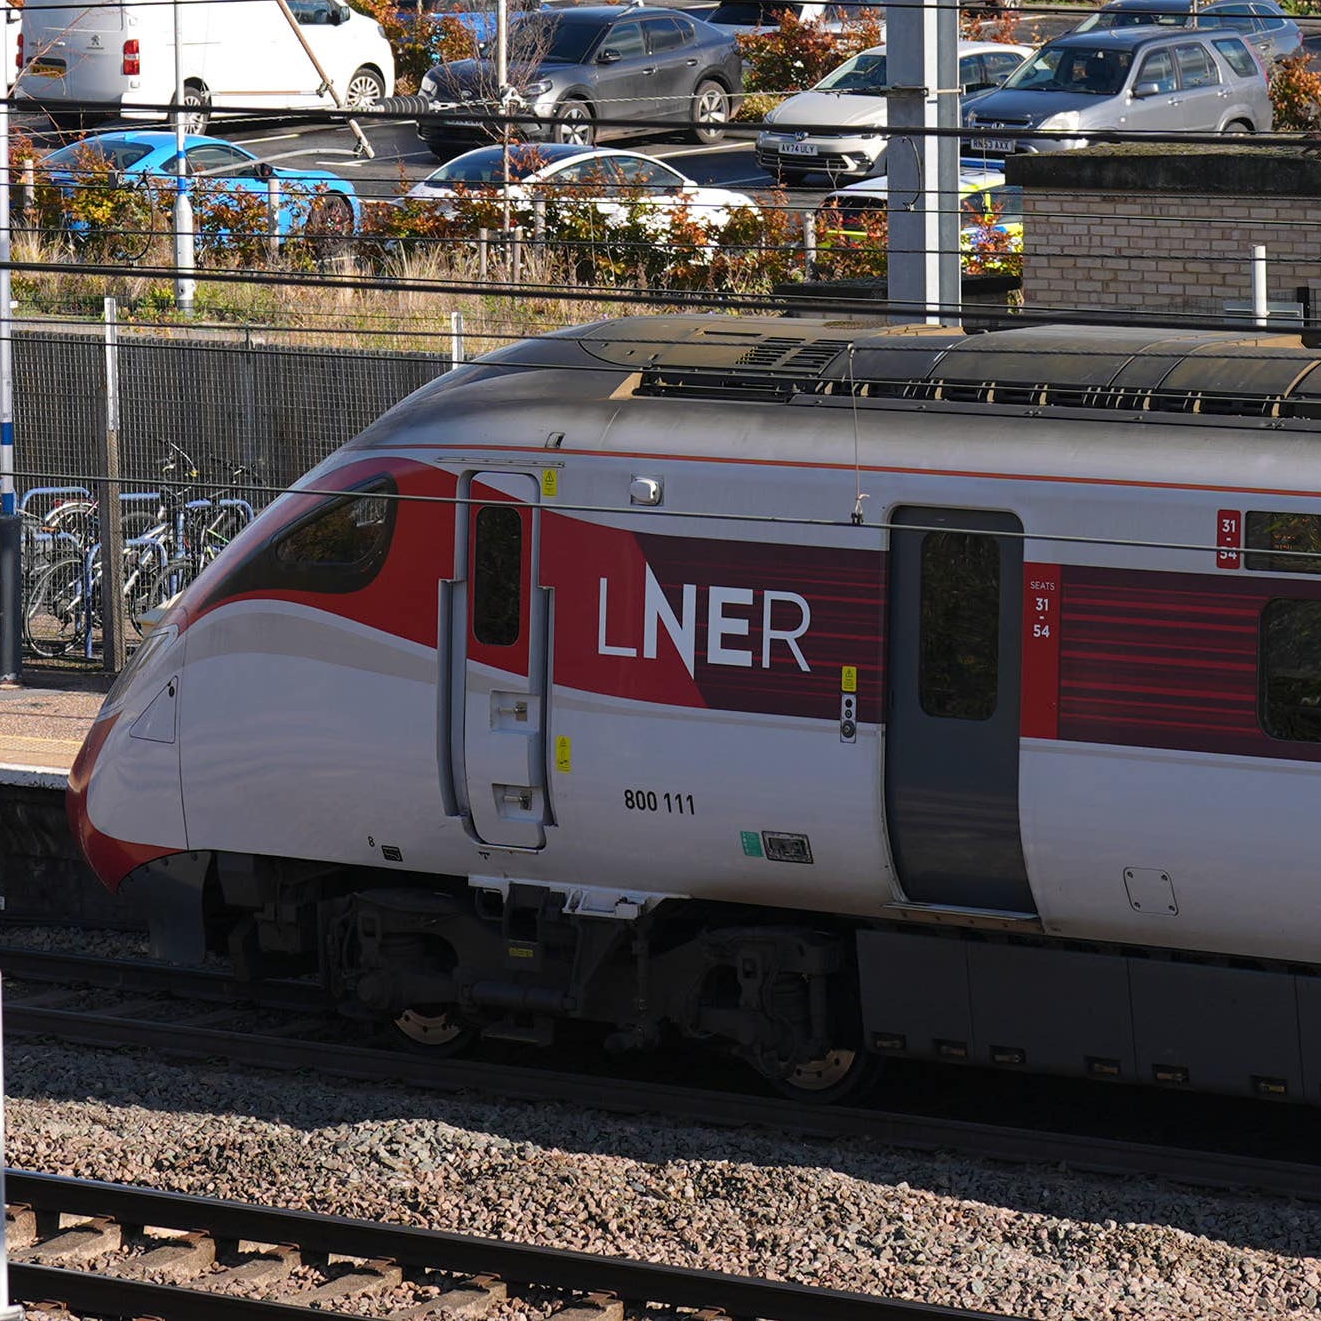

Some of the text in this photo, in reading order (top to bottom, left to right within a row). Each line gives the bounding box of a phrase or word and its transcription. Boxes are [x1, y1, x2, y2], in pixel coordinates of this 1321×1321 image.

[1222, 519, 1236, 533] 31
[1030, 580, 1055, 591] SEATS
[1035, 597, 1049, 611] 31
[598, 562, 811, 680] LNER
[1033, 624, 1050, 638] 54
[624, 789, 695, 816] 800 111
[367, 835, 376, 848] 8
